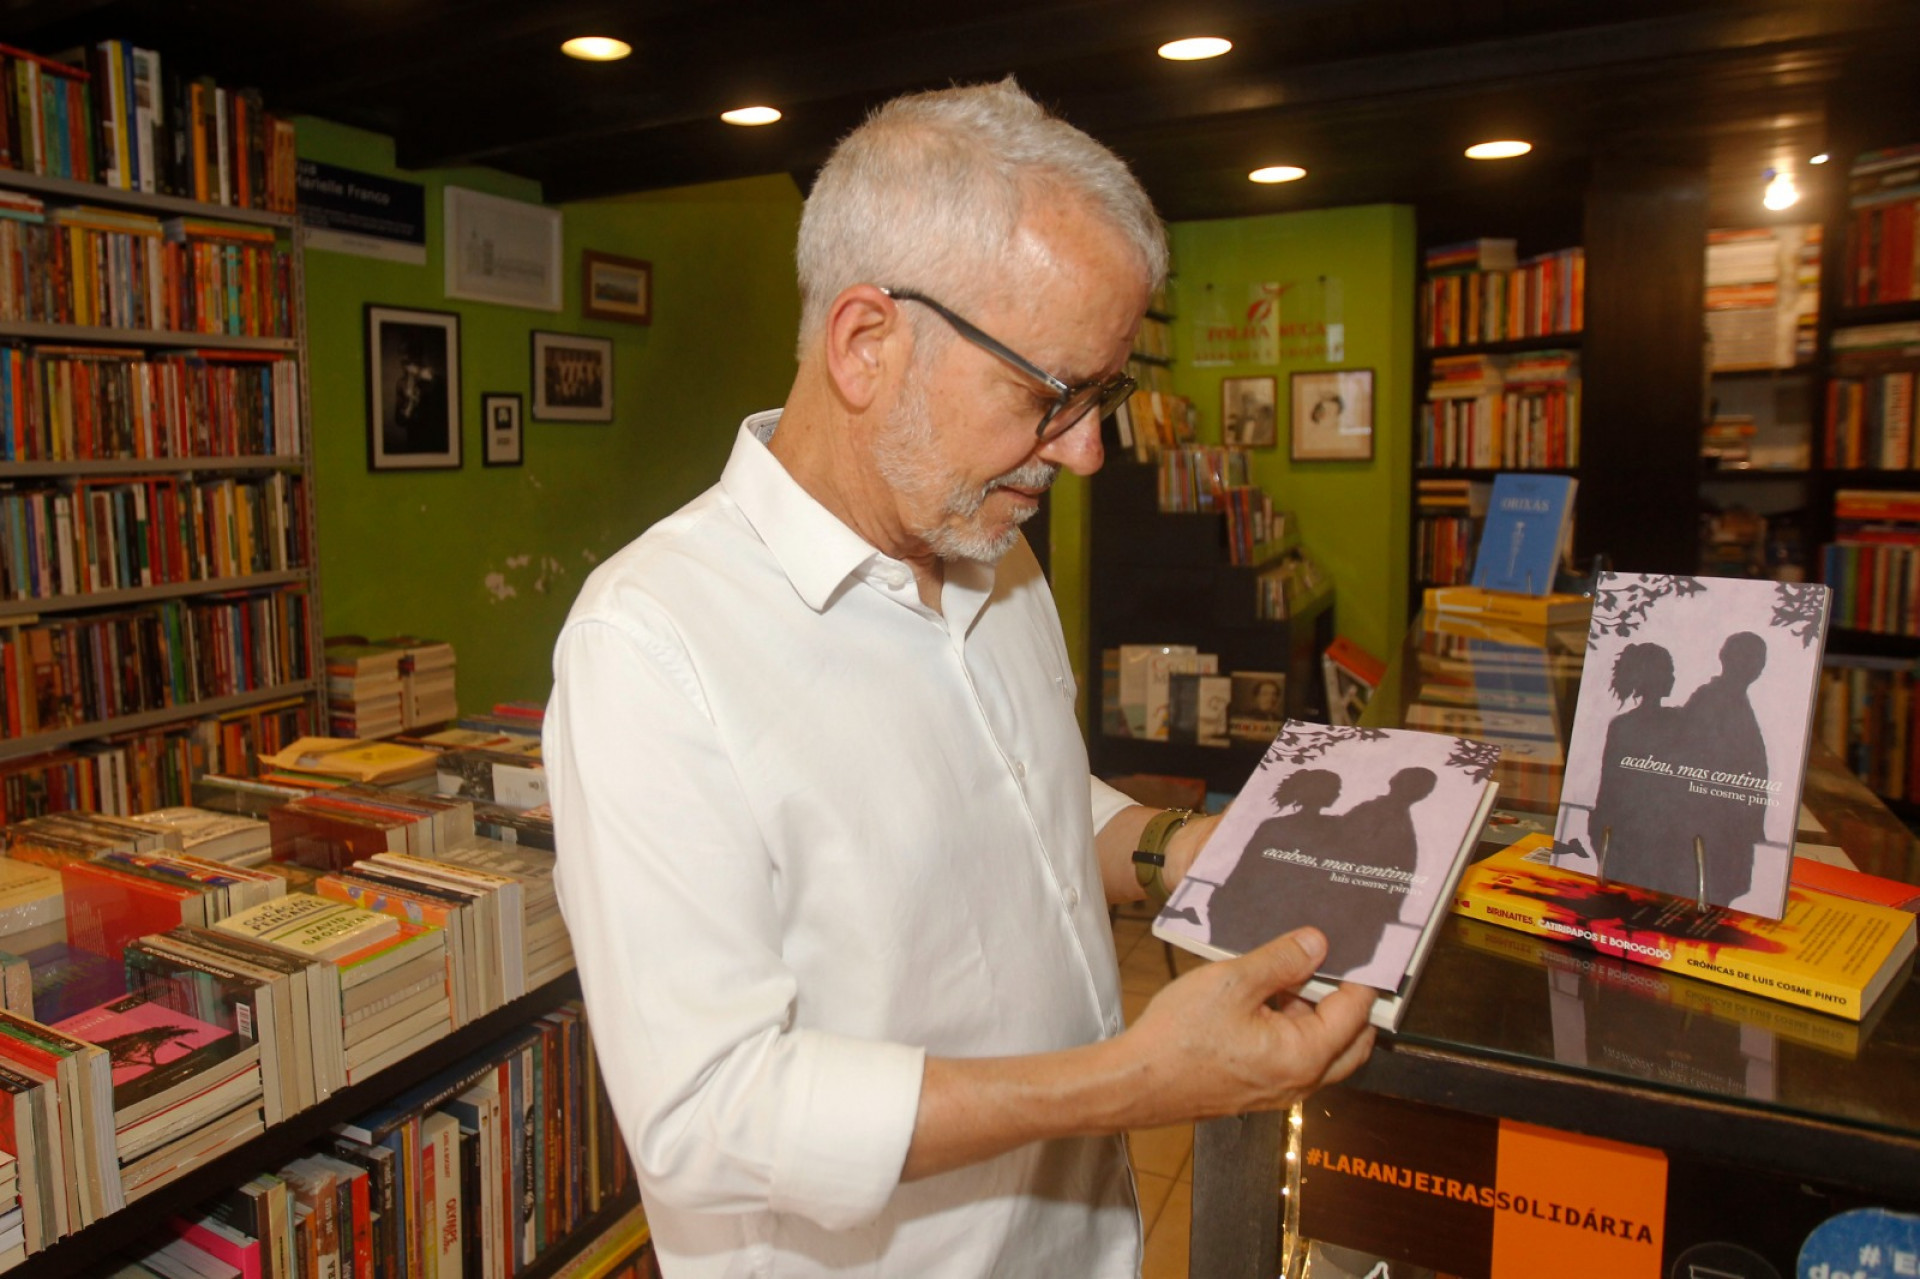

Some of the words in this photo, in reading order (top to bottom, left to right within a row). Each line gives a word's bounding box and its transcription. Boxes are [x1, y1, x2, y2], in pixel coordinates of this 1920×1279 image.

[347, 183, 391, 206] Franco
[1620, 754, 1674, 776] acabou,
[1677, 765, 1710, 779] mas
[1711, 770, 1783, 793] continua
[1688, 781, 1708, 794] luis
[1710, 788, 1746, 801] cosme
[1748, 794, 1780, 808] pinto
[1261, 847, 1318, 868] acabou,
[1321, 857, 1356, 873] mas
[1356, 865, 1429, 884] continua
[1329, 871, 1350, 884] luis
[1352, 878, 1389, 891] cosme
[1388, 883, 1423, 896] pinto
[251, 901, 327, 931] PENSANTE
[304, 915, 347, 936] DAVID
[1537, 918, 1599, 942] CATIRIPAPOS
[1600, 935, 1608, 944] E
[1609, 936, 1672, 961] BOROGODÓ
[1737, 971, 1751, 981] DE
[1752, 974, 1775, 987] LUIS
[1777, 981, 1813, 997] COSME
[1814, 990, 1848, 1005] PINTO
